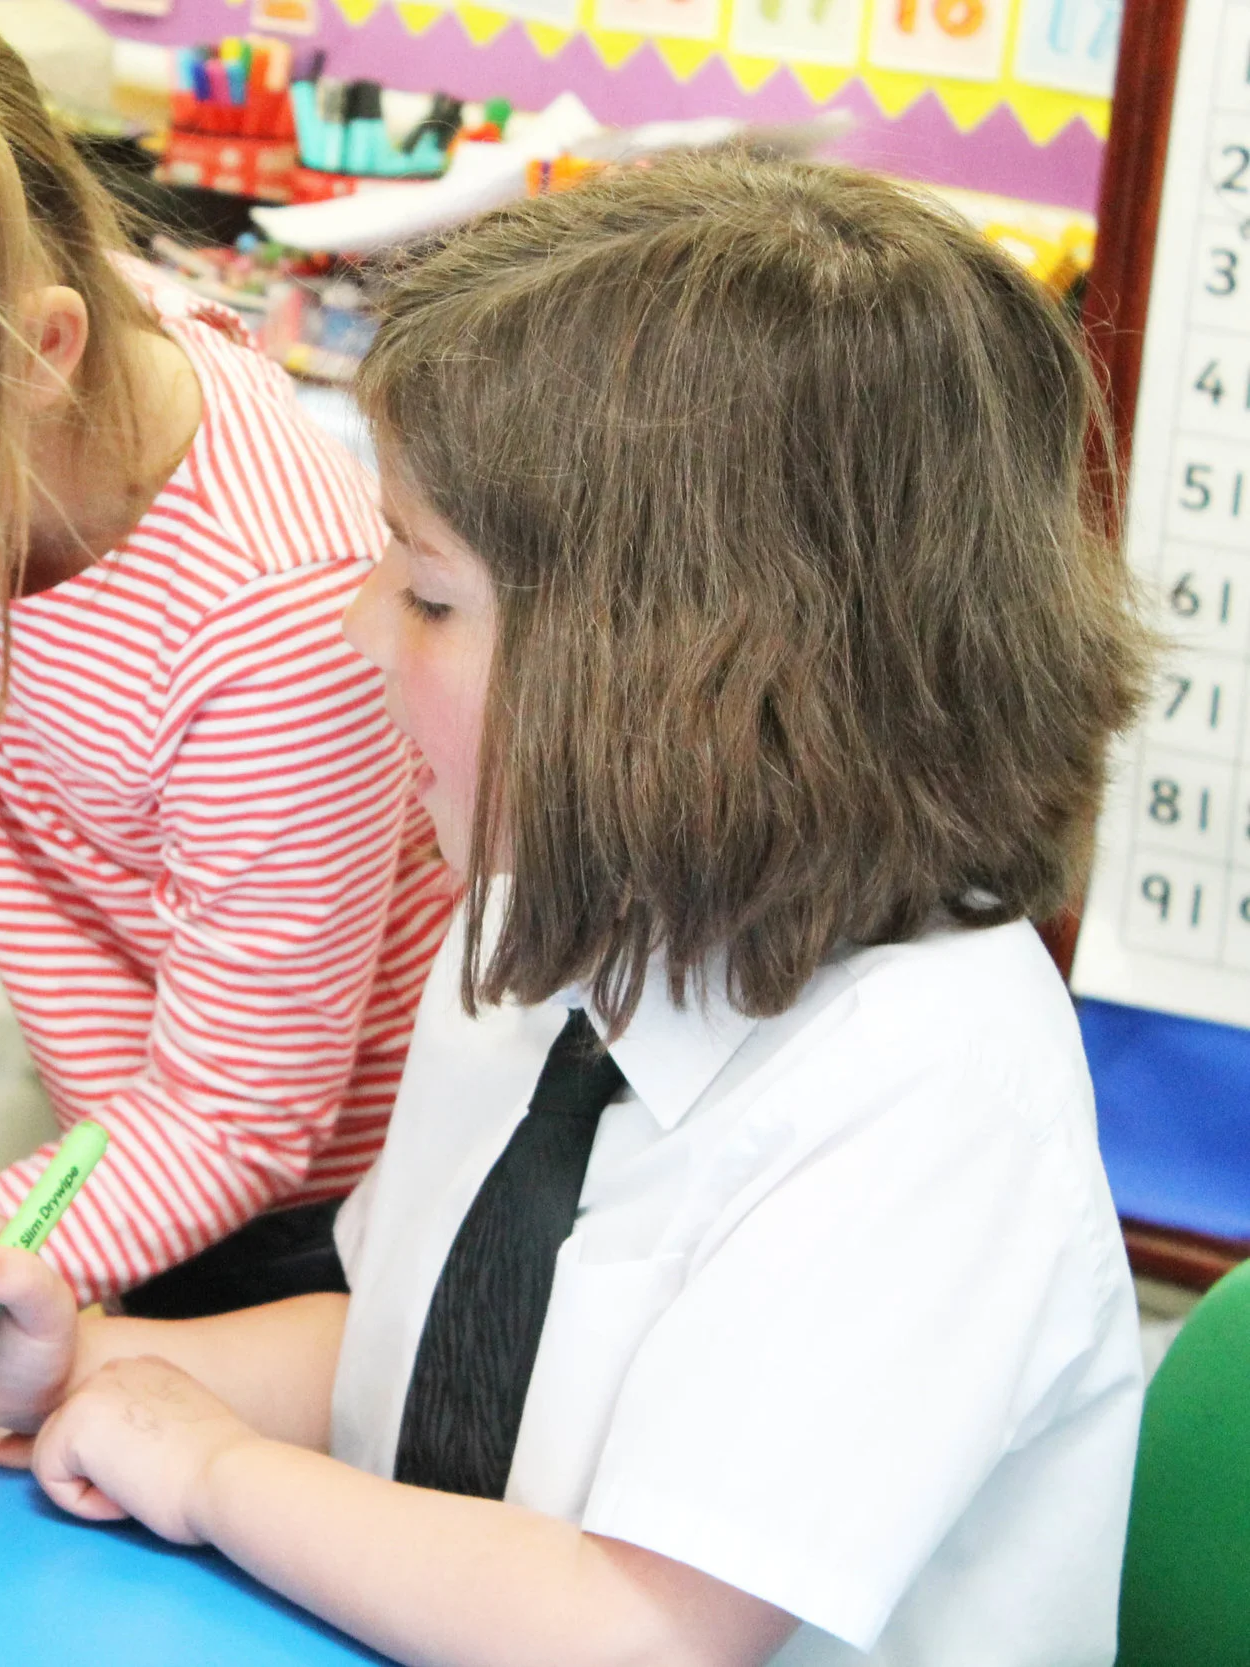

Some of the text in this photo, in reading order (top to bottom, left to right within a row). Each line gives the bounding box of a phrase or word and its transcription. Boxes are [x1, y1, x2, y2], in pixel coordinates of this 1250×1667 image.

[1180, 462, 1244, 518] 51
[1171, 571, 1231, 624] 61
[1163, 673, 1221, 729] 71
[1149, 778, 1210, 832] 81
[1140, 873, 1202, 928] 91
[19, 1165, 80, 1249] Slim Drywipe
